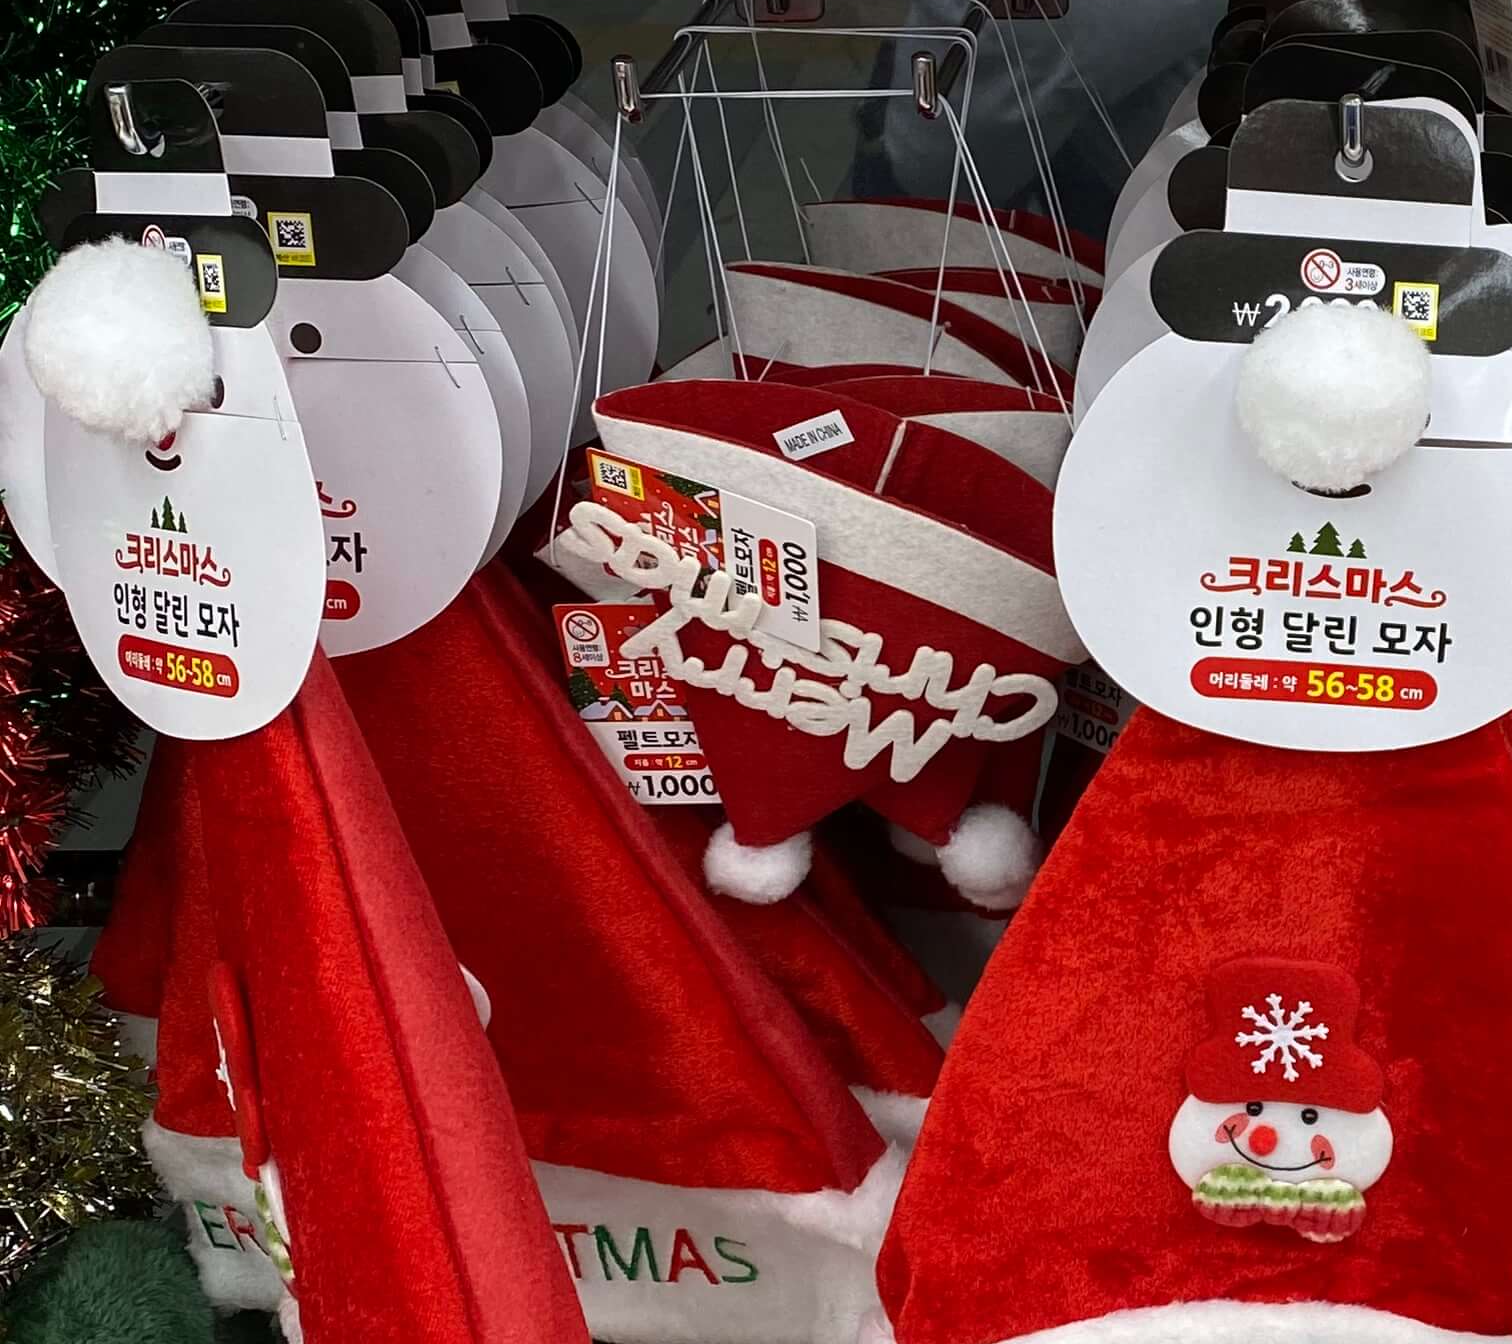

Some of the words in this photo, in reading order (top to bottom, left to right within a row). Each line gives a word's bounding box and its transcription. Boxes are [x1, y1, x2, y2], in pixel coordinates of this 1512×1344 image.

[783, 432, 810, 453] MADE
[806, 430, 819, 445] IN
[816, 422, 844, 442] CHINA
[115, 533, 231, 587] 크리스마스
[731, 527, 758, 595] 펠트모자
[781, 542, 812, 623] ₩1,000
[1200, 556, 1447, 609] 크리스마스
[113, 582, 147, 630] 인형
[154, 590, 188, 638] 달린
[196, 602, 240, 648] 모자
[1190, 606, 1264, 651] 인형
[1283, 610, 1358, 656] 달린
[1372, 622, 1452, 664] 모자
[216, 672, 232, 687] cm
[604, 659, 668, 680] 크리
[630, 681, 677, 699] 마스
[1209, 670, 1269, 690] 머리둘레
[1282, 673, 1298, 693] 약
[1306, 669, 1395, 702] 56~58
[1400, 687, 1424, 700] cm
[665, 755, 683, 768] 12
